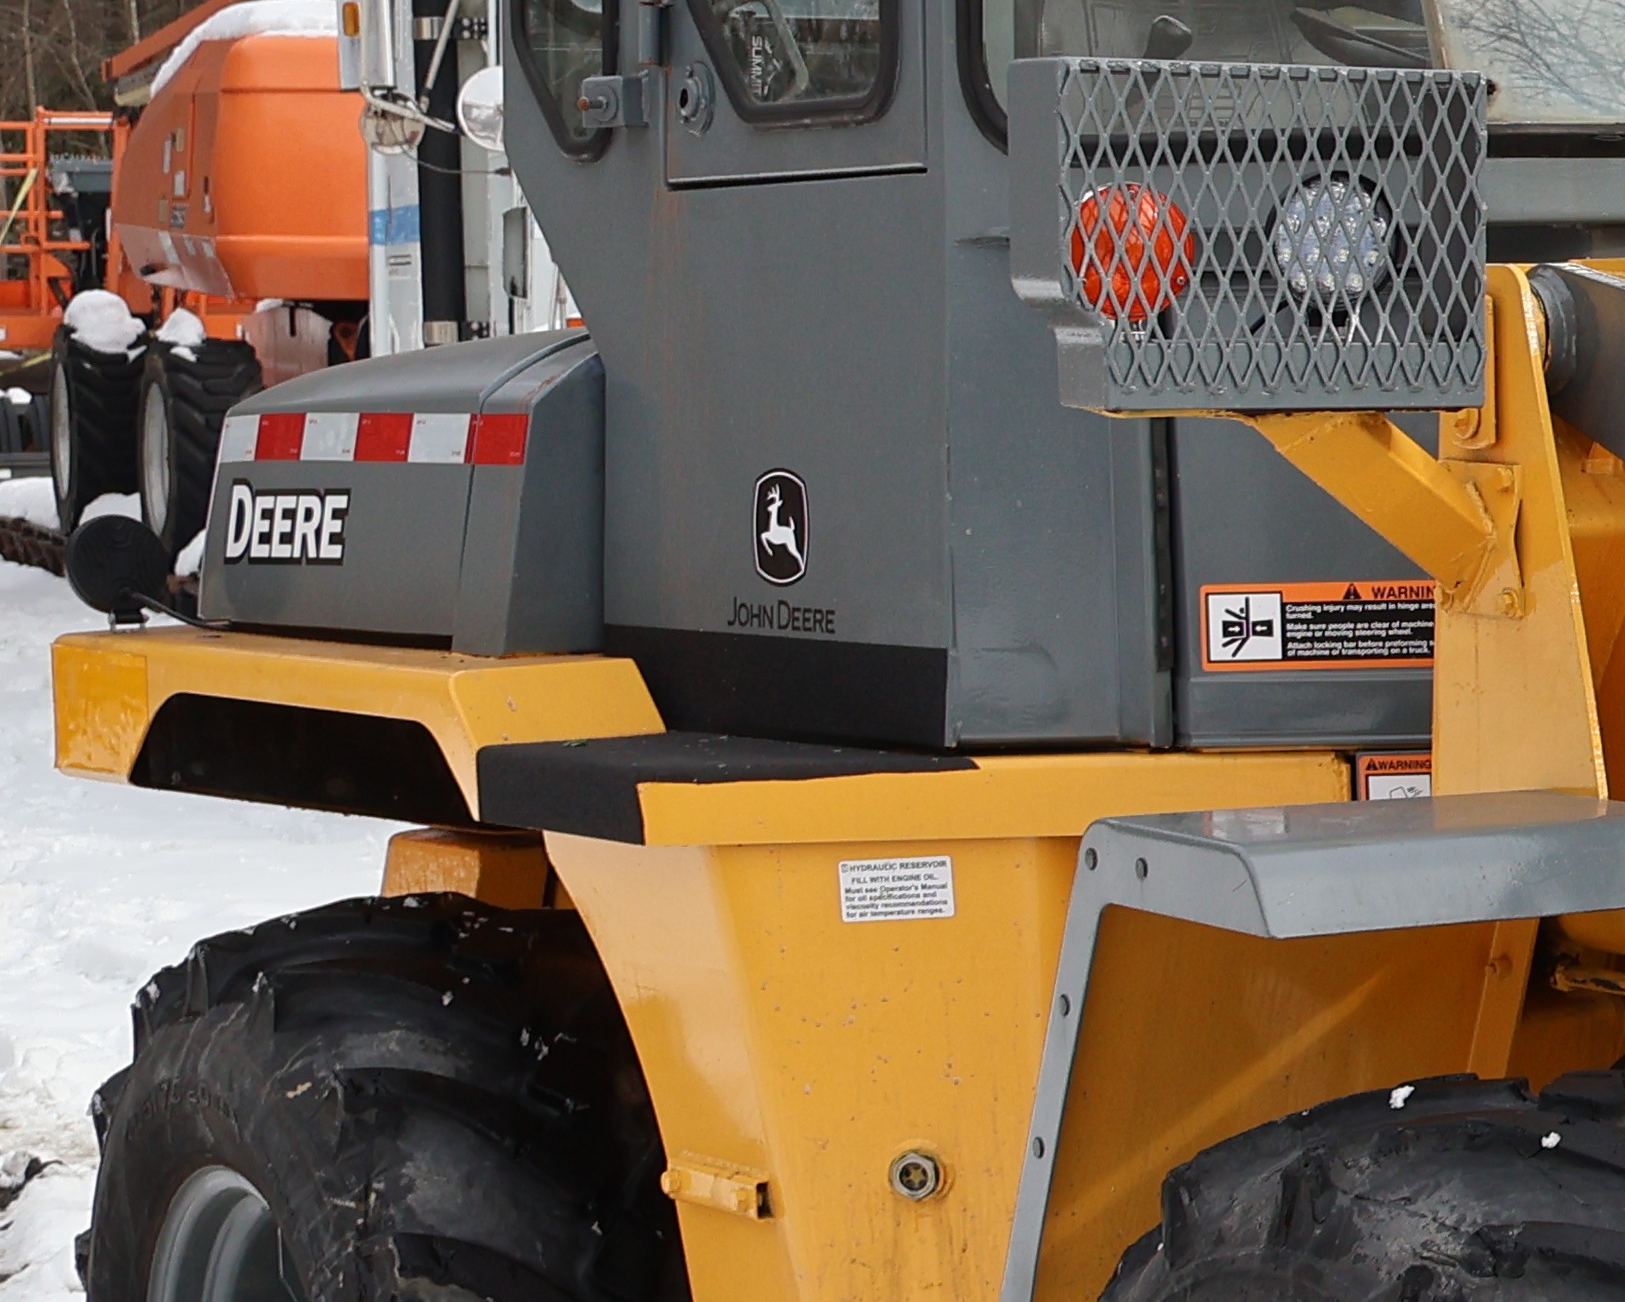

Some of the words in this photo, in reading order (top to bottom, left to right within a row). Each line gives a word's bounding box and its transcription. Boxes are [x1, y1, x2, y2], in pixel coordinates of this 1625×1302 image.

[751, 35, 764, 96] SUMMIT
[225, 483, 350, 559] DEERE
[1371, 585, 1436, 600] WARNIN
[1285, 604, 1321, 614] Crushing
[1323, 604, 1344, 613] injury
[1346, 604, 1363, 612] may
[1364, 603, 1387, 611] result
[1388, 602, 1396, 610] in
[1397, 602, 1419, 612] hinge
[727, 596, 775, 630] JOHN
[777, 599, 837, 635] DEERE
[1286, 622, 1307, 630] Make
[1328, 622, 1355, 631] people
[1370, 621, 1390, 629] clear
[1391, 620, 1400, 628] of
[1401, 620, 1434, 628] machine
[1286, 630, 1313, 639] engine
[1324, 629, 1354, 638] moving
[1355, 629, 1387, 638] steering
[1388, 628, 1413, 636] wheel.
[1287, 641, 1313, 649] Attach
[1313, 640, 1342, 650] locking
[1343, 640, 1357, 648] bar
[1358, 640, 1384, 648] before
[1287, 649, 1296, 657] of
[1297, 648, 1330, 656] machine
[1341, 647, 1389, 656] transporting
[1409, 646, 1431, 654] truck.
[1377, 759, 1432, 771] WARNING
[849, 862, 897, 872] HYDRAULIC
[899, 860, 948, 870] RESERVOIR
[851, 877, 868, 885] FILL
[869, 876, 891, 884] WITH
[891, 874, 922, 883] ENGINE
[844, 886, 864, 895] Must
[879, 884, 919, 893] Operator's
[921, 882, 948, 891] Manual
[869, 892, 921, 901] specifications
[845, 902, 880, 911] viscosity
[881, 899, 949, 908] recommendations
[870, 908, 916, 917] temperature
[917, 907, 945, 915] ranges.
